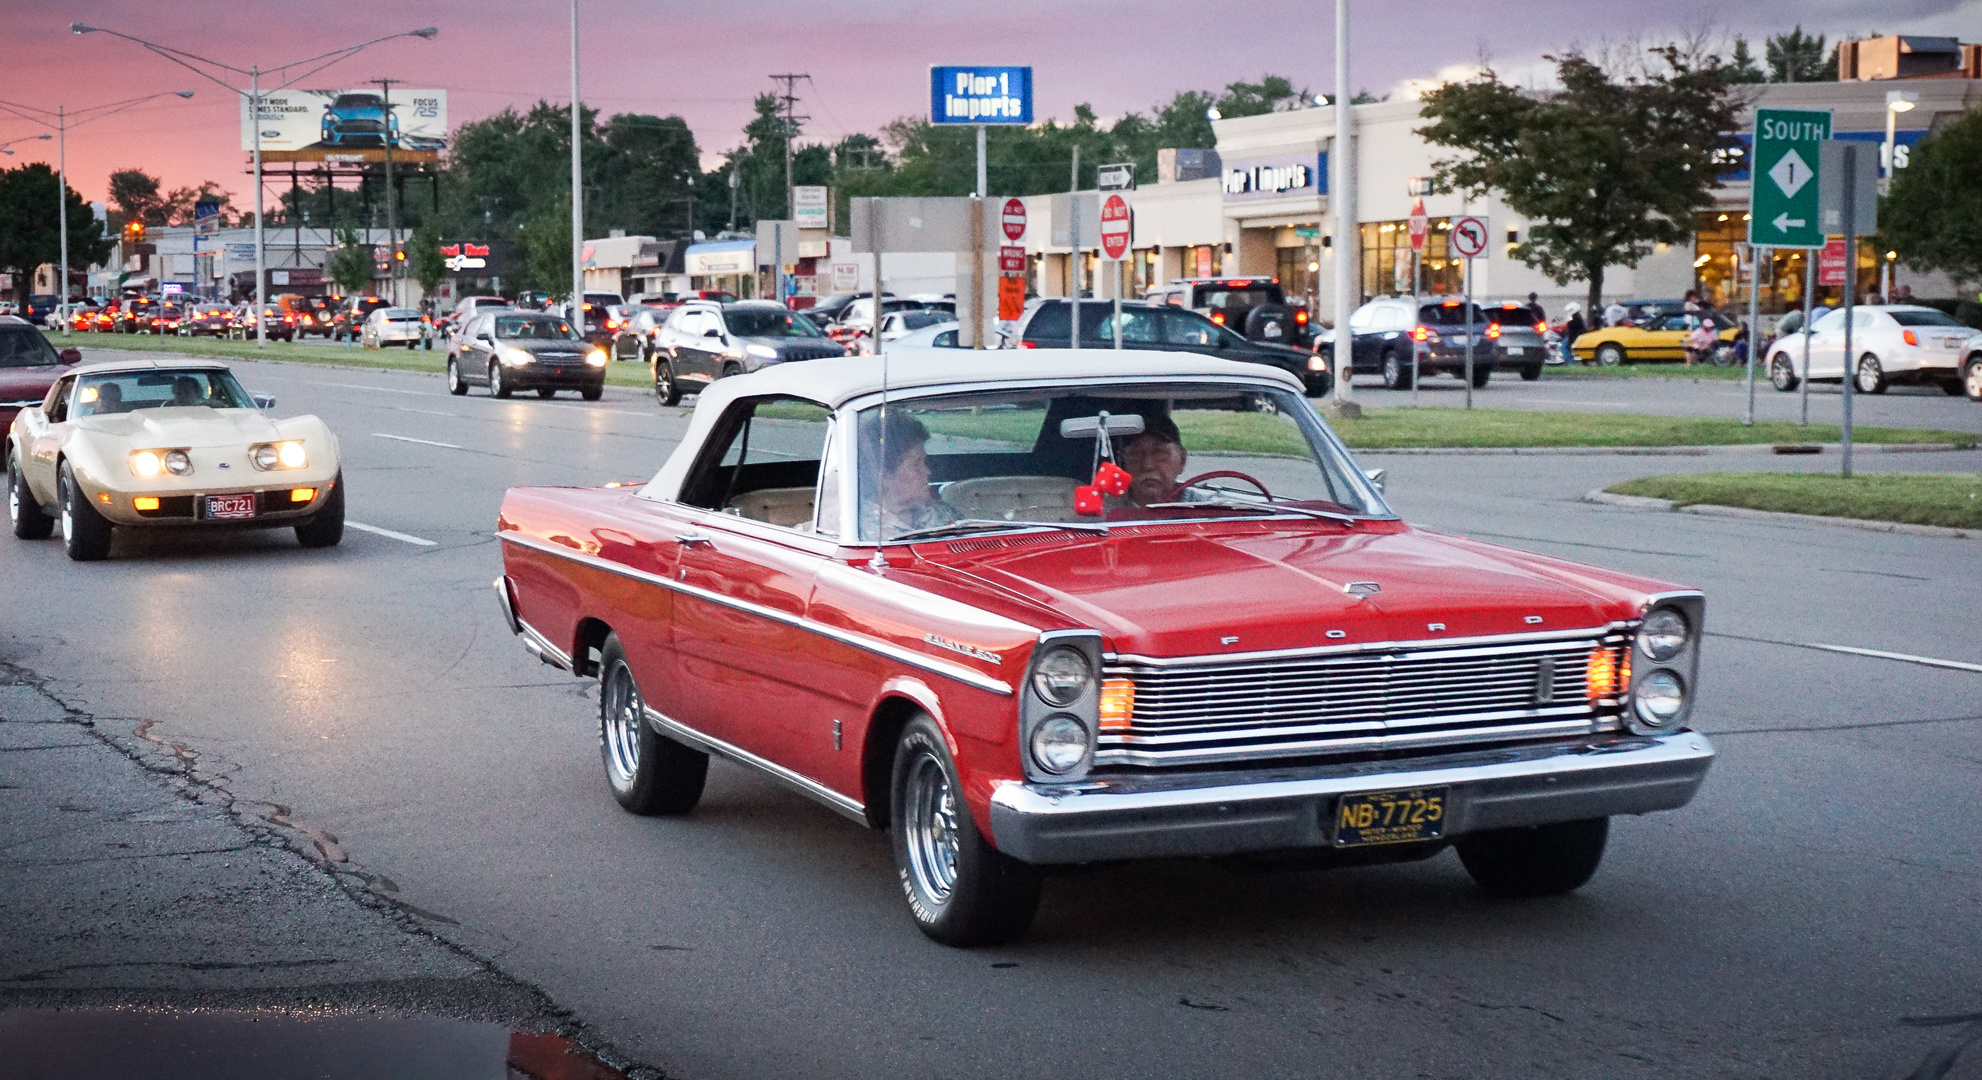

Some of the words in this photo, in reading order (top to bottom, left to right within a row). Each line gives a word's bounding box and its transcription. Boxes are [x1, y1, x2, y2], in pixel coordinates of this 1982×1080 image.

[957, 72, 997, 95] Pier
[999, 72, 1009, 95] 1
[249, 105, 272, 113] CMES
[413, 98, 439, 106] FOCUS
[945, 93, 1021, 120] Imports
[1762, 118, 1825, 142] SOUTH
[1223, 168, 1249, 194] Pier
[1259, 164, 1307, 193] Imports
[1788, 162, 1794, 185] 1
[1103, 207, 1112, 219] DO
[1114, 206, 1127, 217] NOT
[1408, 214, 1428, 235] STOP
[1106, 235, 1125, 248] ENTER
[211, 499, 252, 512] BRC721
